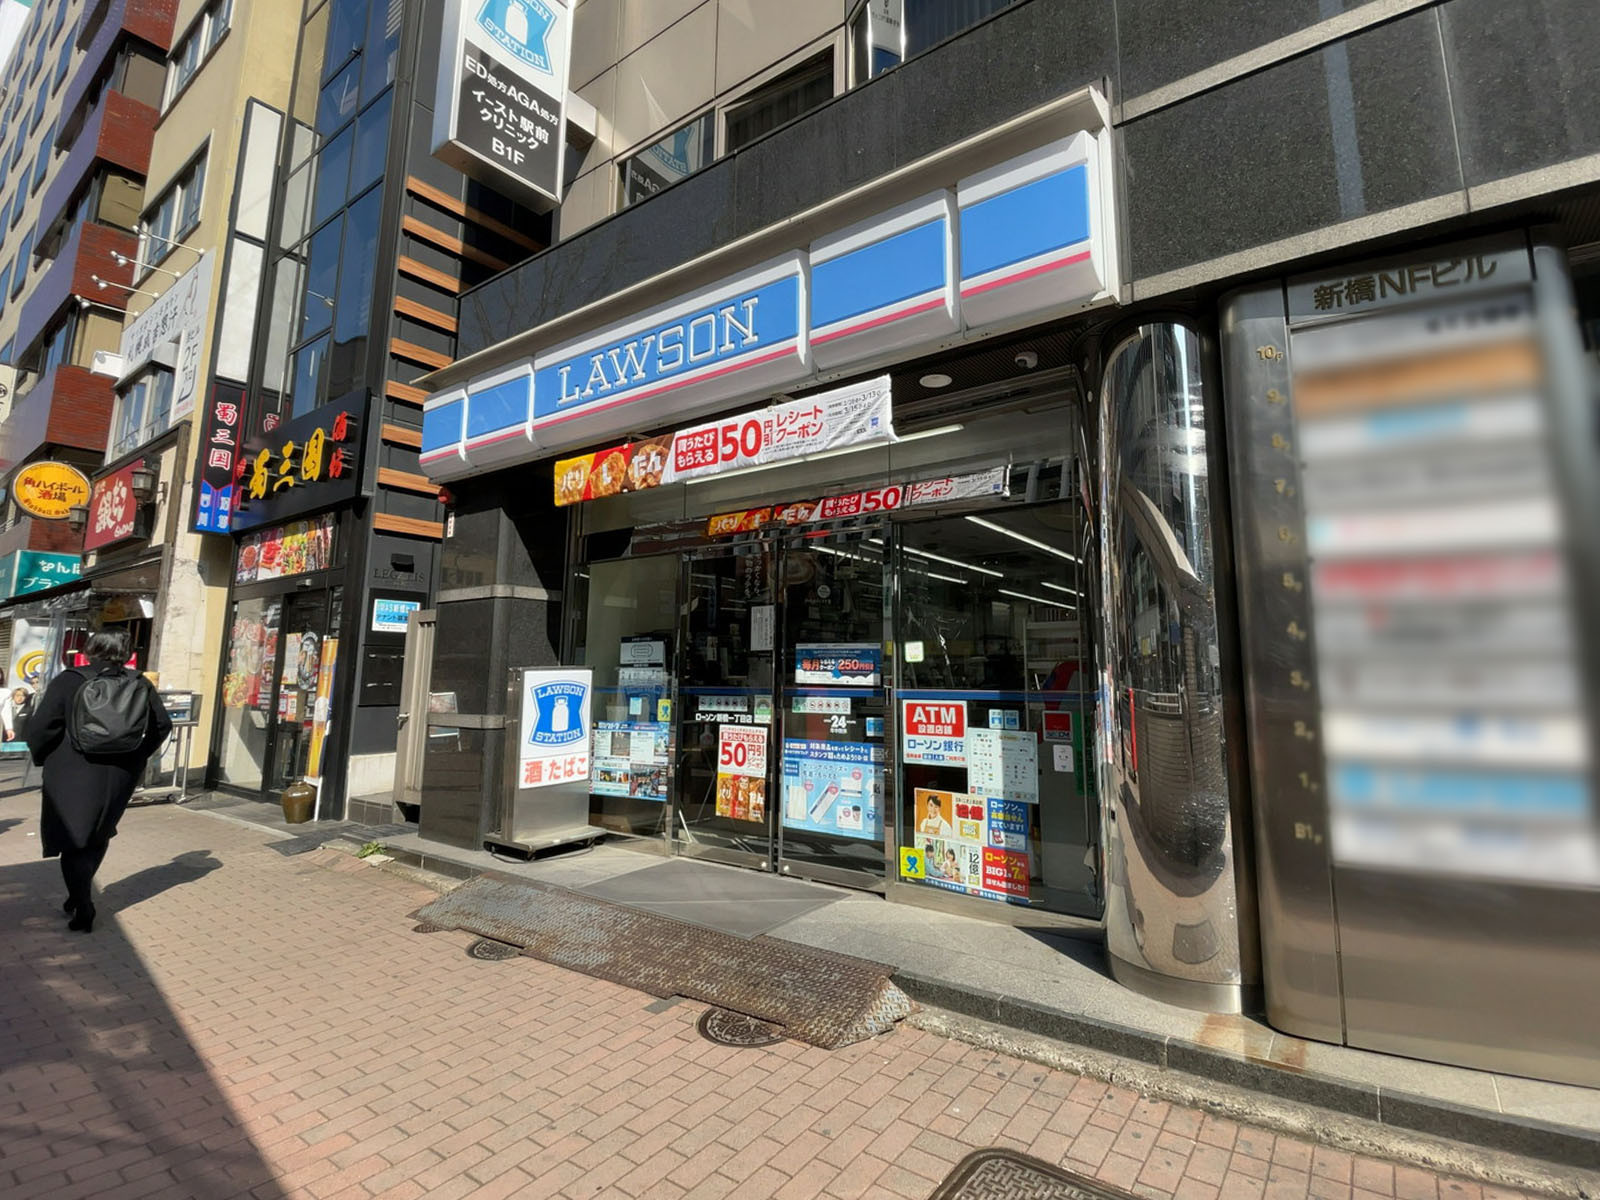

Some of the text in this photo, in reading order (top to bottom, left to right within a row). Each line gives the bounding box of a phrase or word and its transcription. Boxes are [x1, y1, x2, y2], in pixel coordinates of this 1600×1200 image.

[483, 17, 546, 68] STATION
[472, 90, 549, 145] イースト駅前
[479, 107, 540, 150] クリニック
[491, 136, 525, 165] B1F
[1313, 255, 1498, 311] 新橋NFビル
[555, 296, 759, 406] LAWSON
[776, 405, 823, 428] レシート
[208, 401, 238, 471] 蜀三国
[677, 431, 715, 453] 買うたび
[721, 419, 762, 462] 50
[776, 421, 824, 443] クーポン
[676, 448, 714, 468] もらえる
[24, 476, 85, 495] 角ハイボール
[864, 486, 901, 511] 50
[537, 684, 584, 698] LAWSON
[830, 714, 848, 729] 24
[912, 706, 957, 724] ATM
[535, 728, 582, 743] STATION
[907, 739, 964, 752] ローソン銀行
[720, 741, 747, 767] 50
